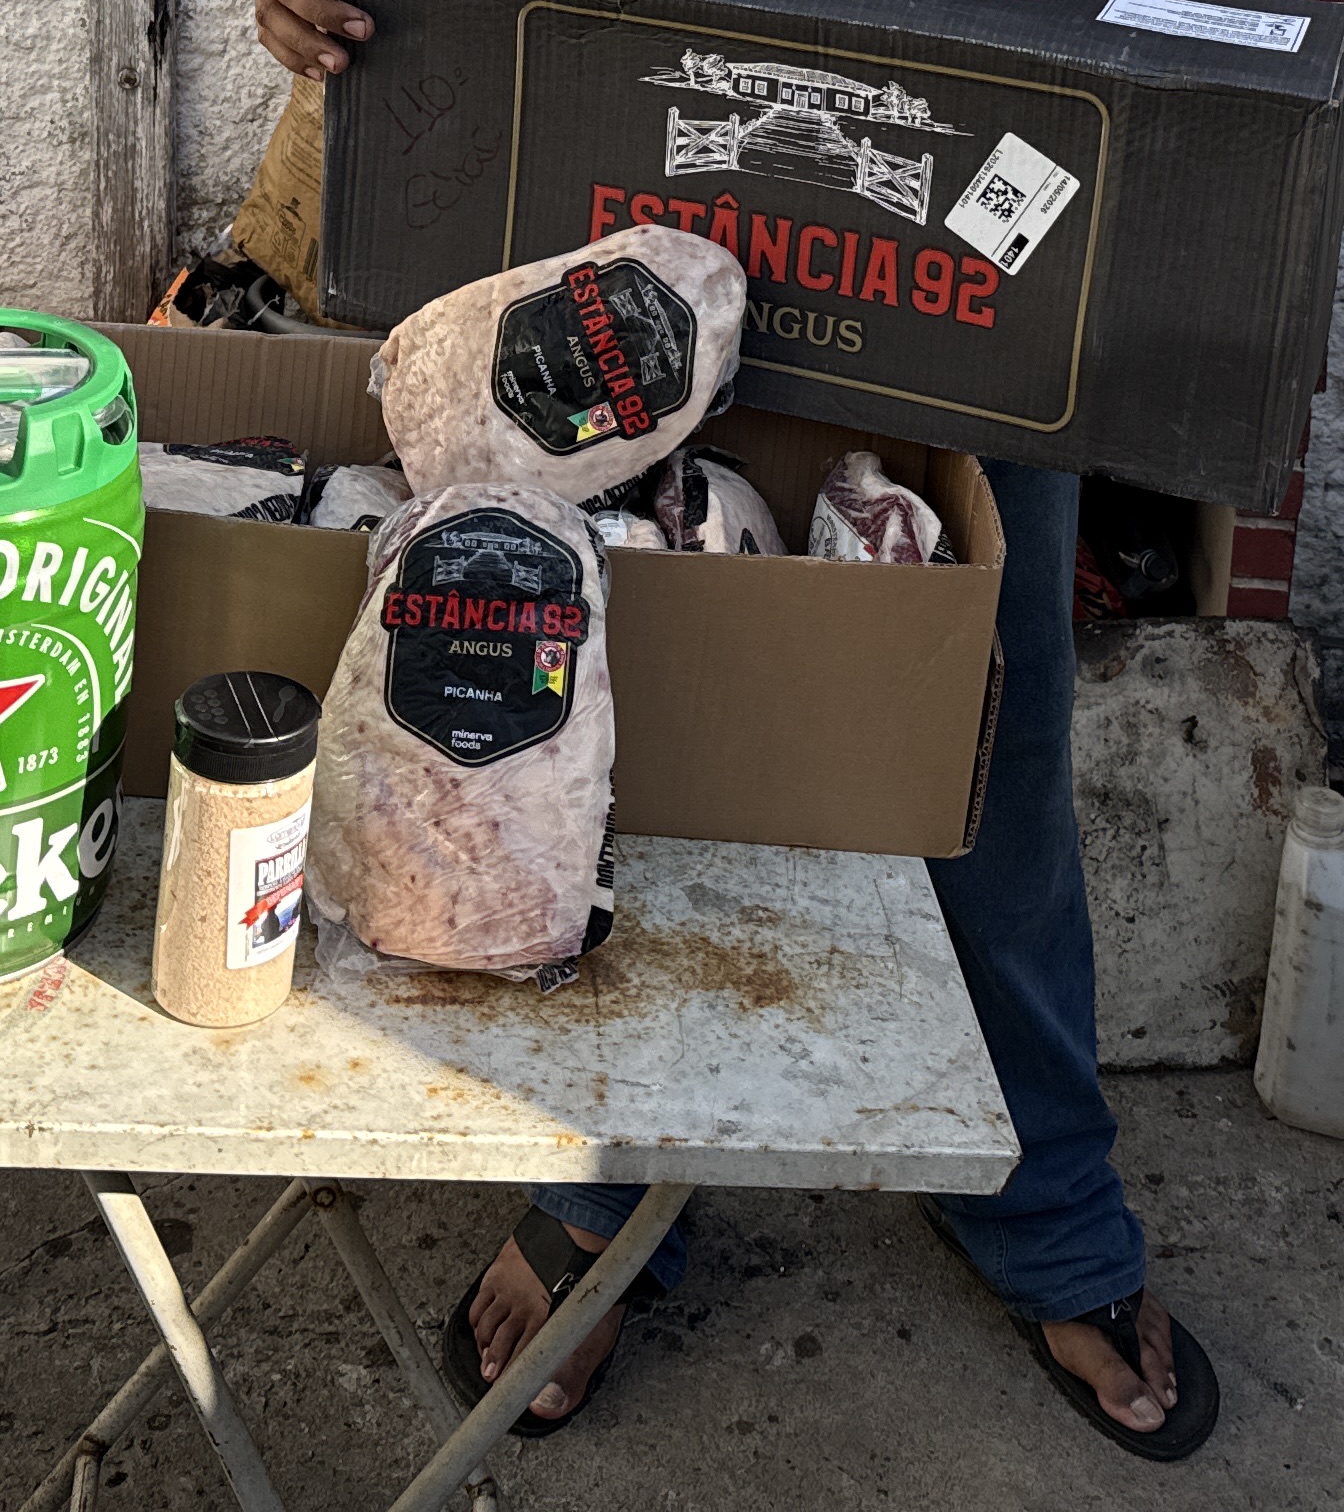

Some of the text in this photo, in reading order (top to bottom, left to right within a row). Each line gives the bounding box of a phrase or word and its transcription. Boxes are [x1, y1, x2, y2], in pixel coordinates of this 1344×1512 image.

[1040, 175, 1071, 215] 14/05/2026
[1000, 245, 1020, 269] 1401
[745, 303, 865, 354] NGUS
[531, 344, 557, 396] PICANHA
[567, 335, 596, 388] ANGUS
[505, 370, 525, 406] minerva
[448, 639, 513, 658] ANGUS
[74, 678, 90, 706] EN
[443, 685, 504, 703] PICANHA
[75, 712, 91, 763] 1883
[450, 738, 482, 751] foods
[451, 729, 493, 742] minerva
[17, 747, 60, 775] 1873
[257, 838, 306, 886] PARRILL
